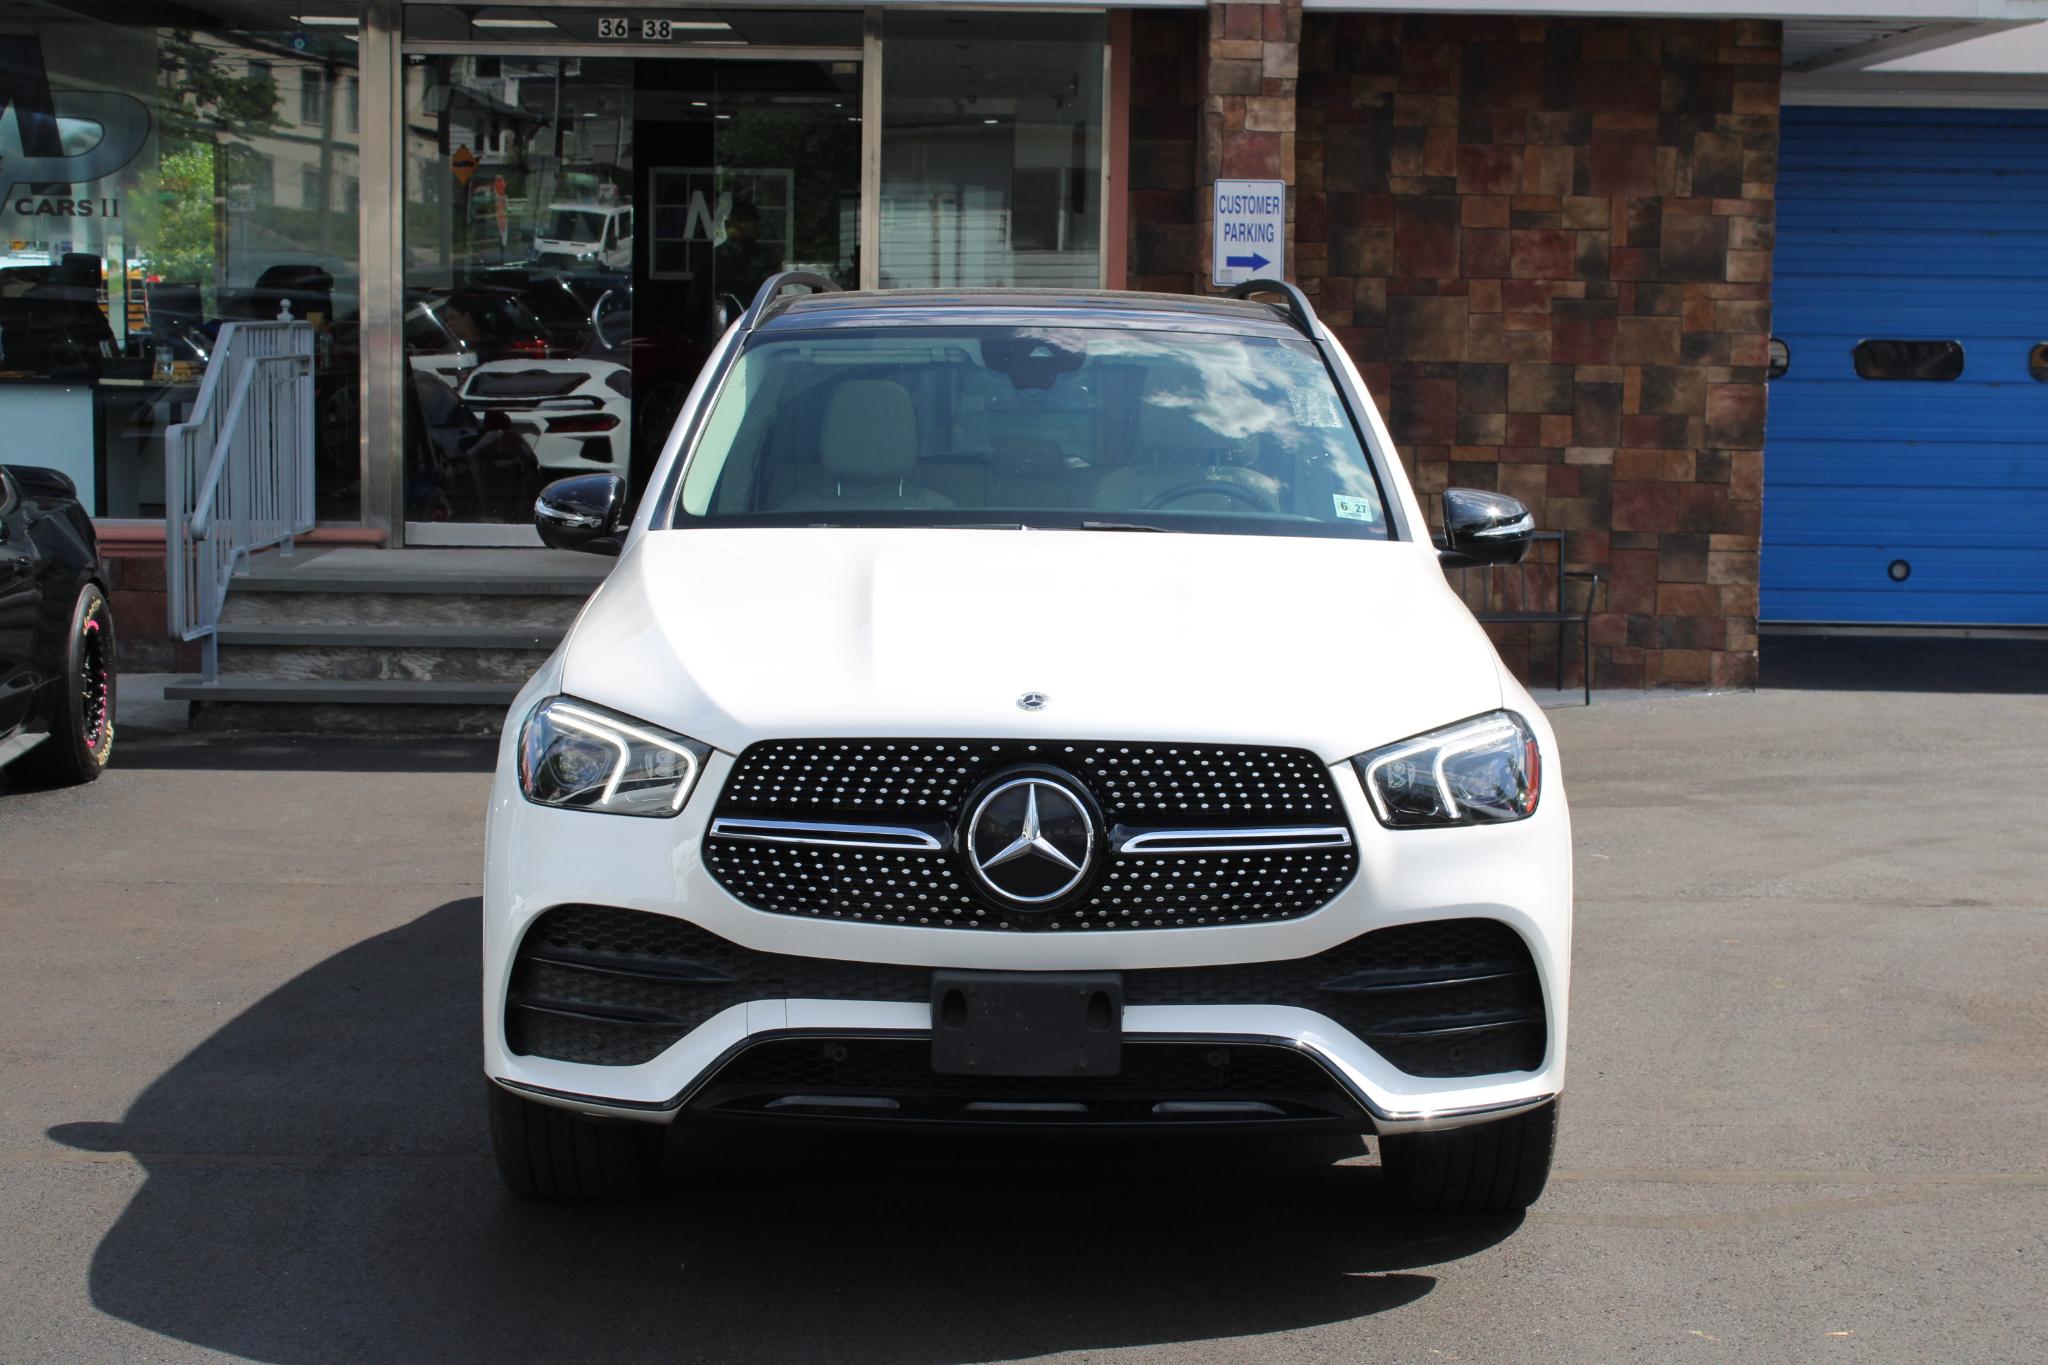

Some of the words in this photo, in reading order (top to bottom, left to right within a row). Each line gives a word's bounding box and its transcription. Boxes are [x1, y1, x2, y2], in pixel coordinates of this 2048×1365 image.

[15, 199, 93, 216] CARS
[1219, 195, 1280, 214] CUSTOMER
[1224, 222, 1275, 242] PARKING
[1340, 501, 1348, 511] 6
[1354, 503, 1366, 514] 27
